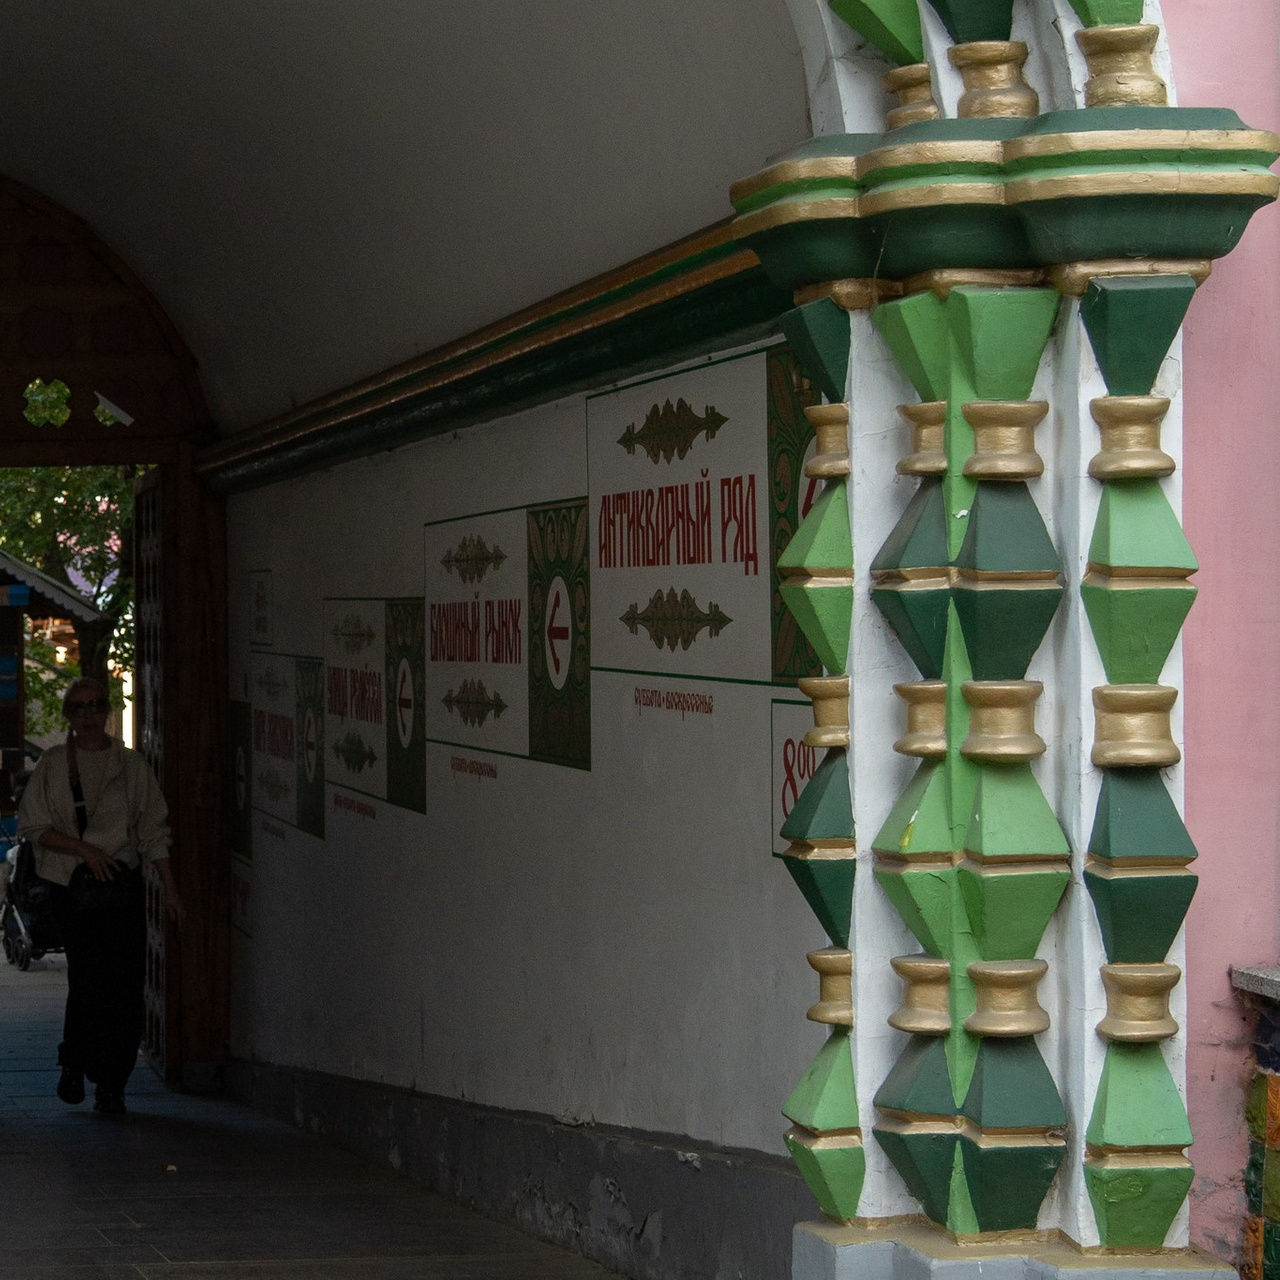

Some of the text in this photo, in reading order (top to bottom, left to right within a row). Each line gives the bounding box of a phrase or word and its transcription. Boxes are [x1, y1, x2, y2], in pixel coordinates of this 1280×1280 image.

[598, 468, 759, 576] АНТИКВАРНЫЙ РЯД
[430, 591, 522, 665] БЛОШИНЫЙ РЫНОК
